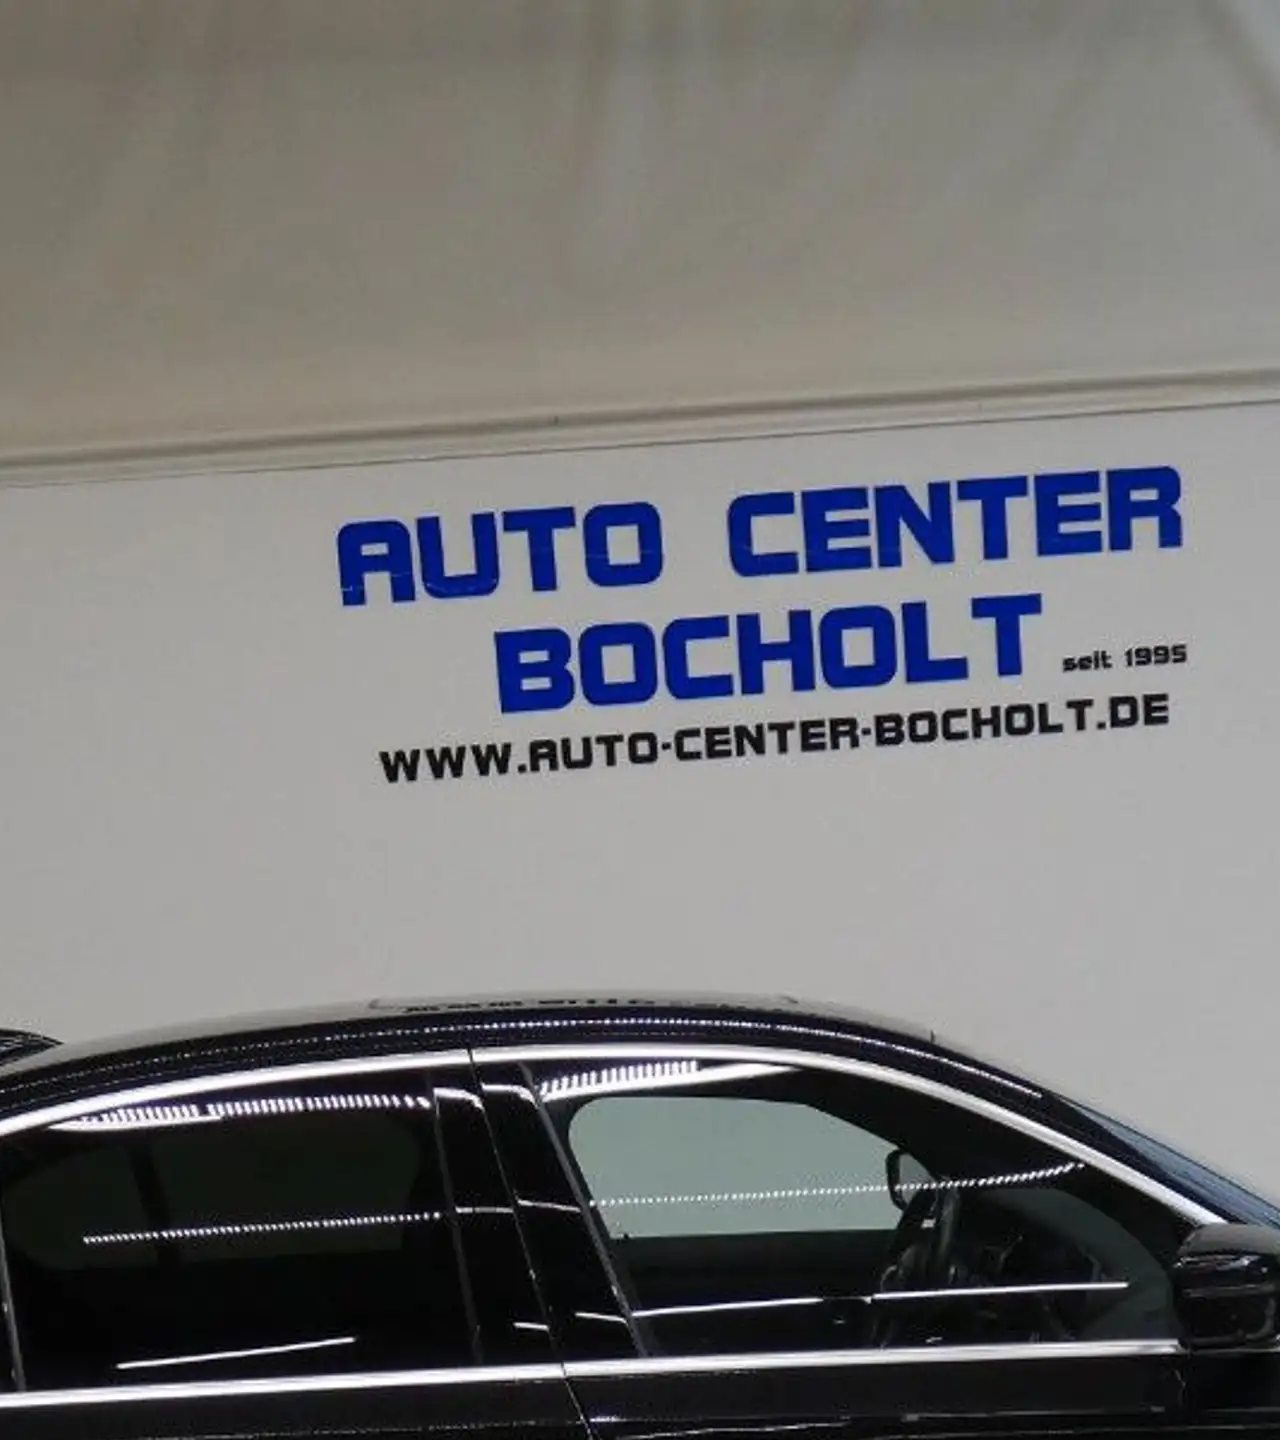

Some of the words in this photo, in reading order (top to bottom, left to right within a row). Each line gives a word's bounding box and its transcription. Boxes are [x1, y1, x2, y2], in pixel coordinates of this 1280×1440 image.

[336, 501, 664, 607] AUTO
[728, 465, 1184, 579] CENTER
[494, 593, 1044, 715] BOCHOLT
[1062, 650, 1113, 672] seit
[1124, 644, 1188, 667] 1995
[378, 692, 1170, 785] WWW.AUTO-CENTER-BOCHOLT.DE
